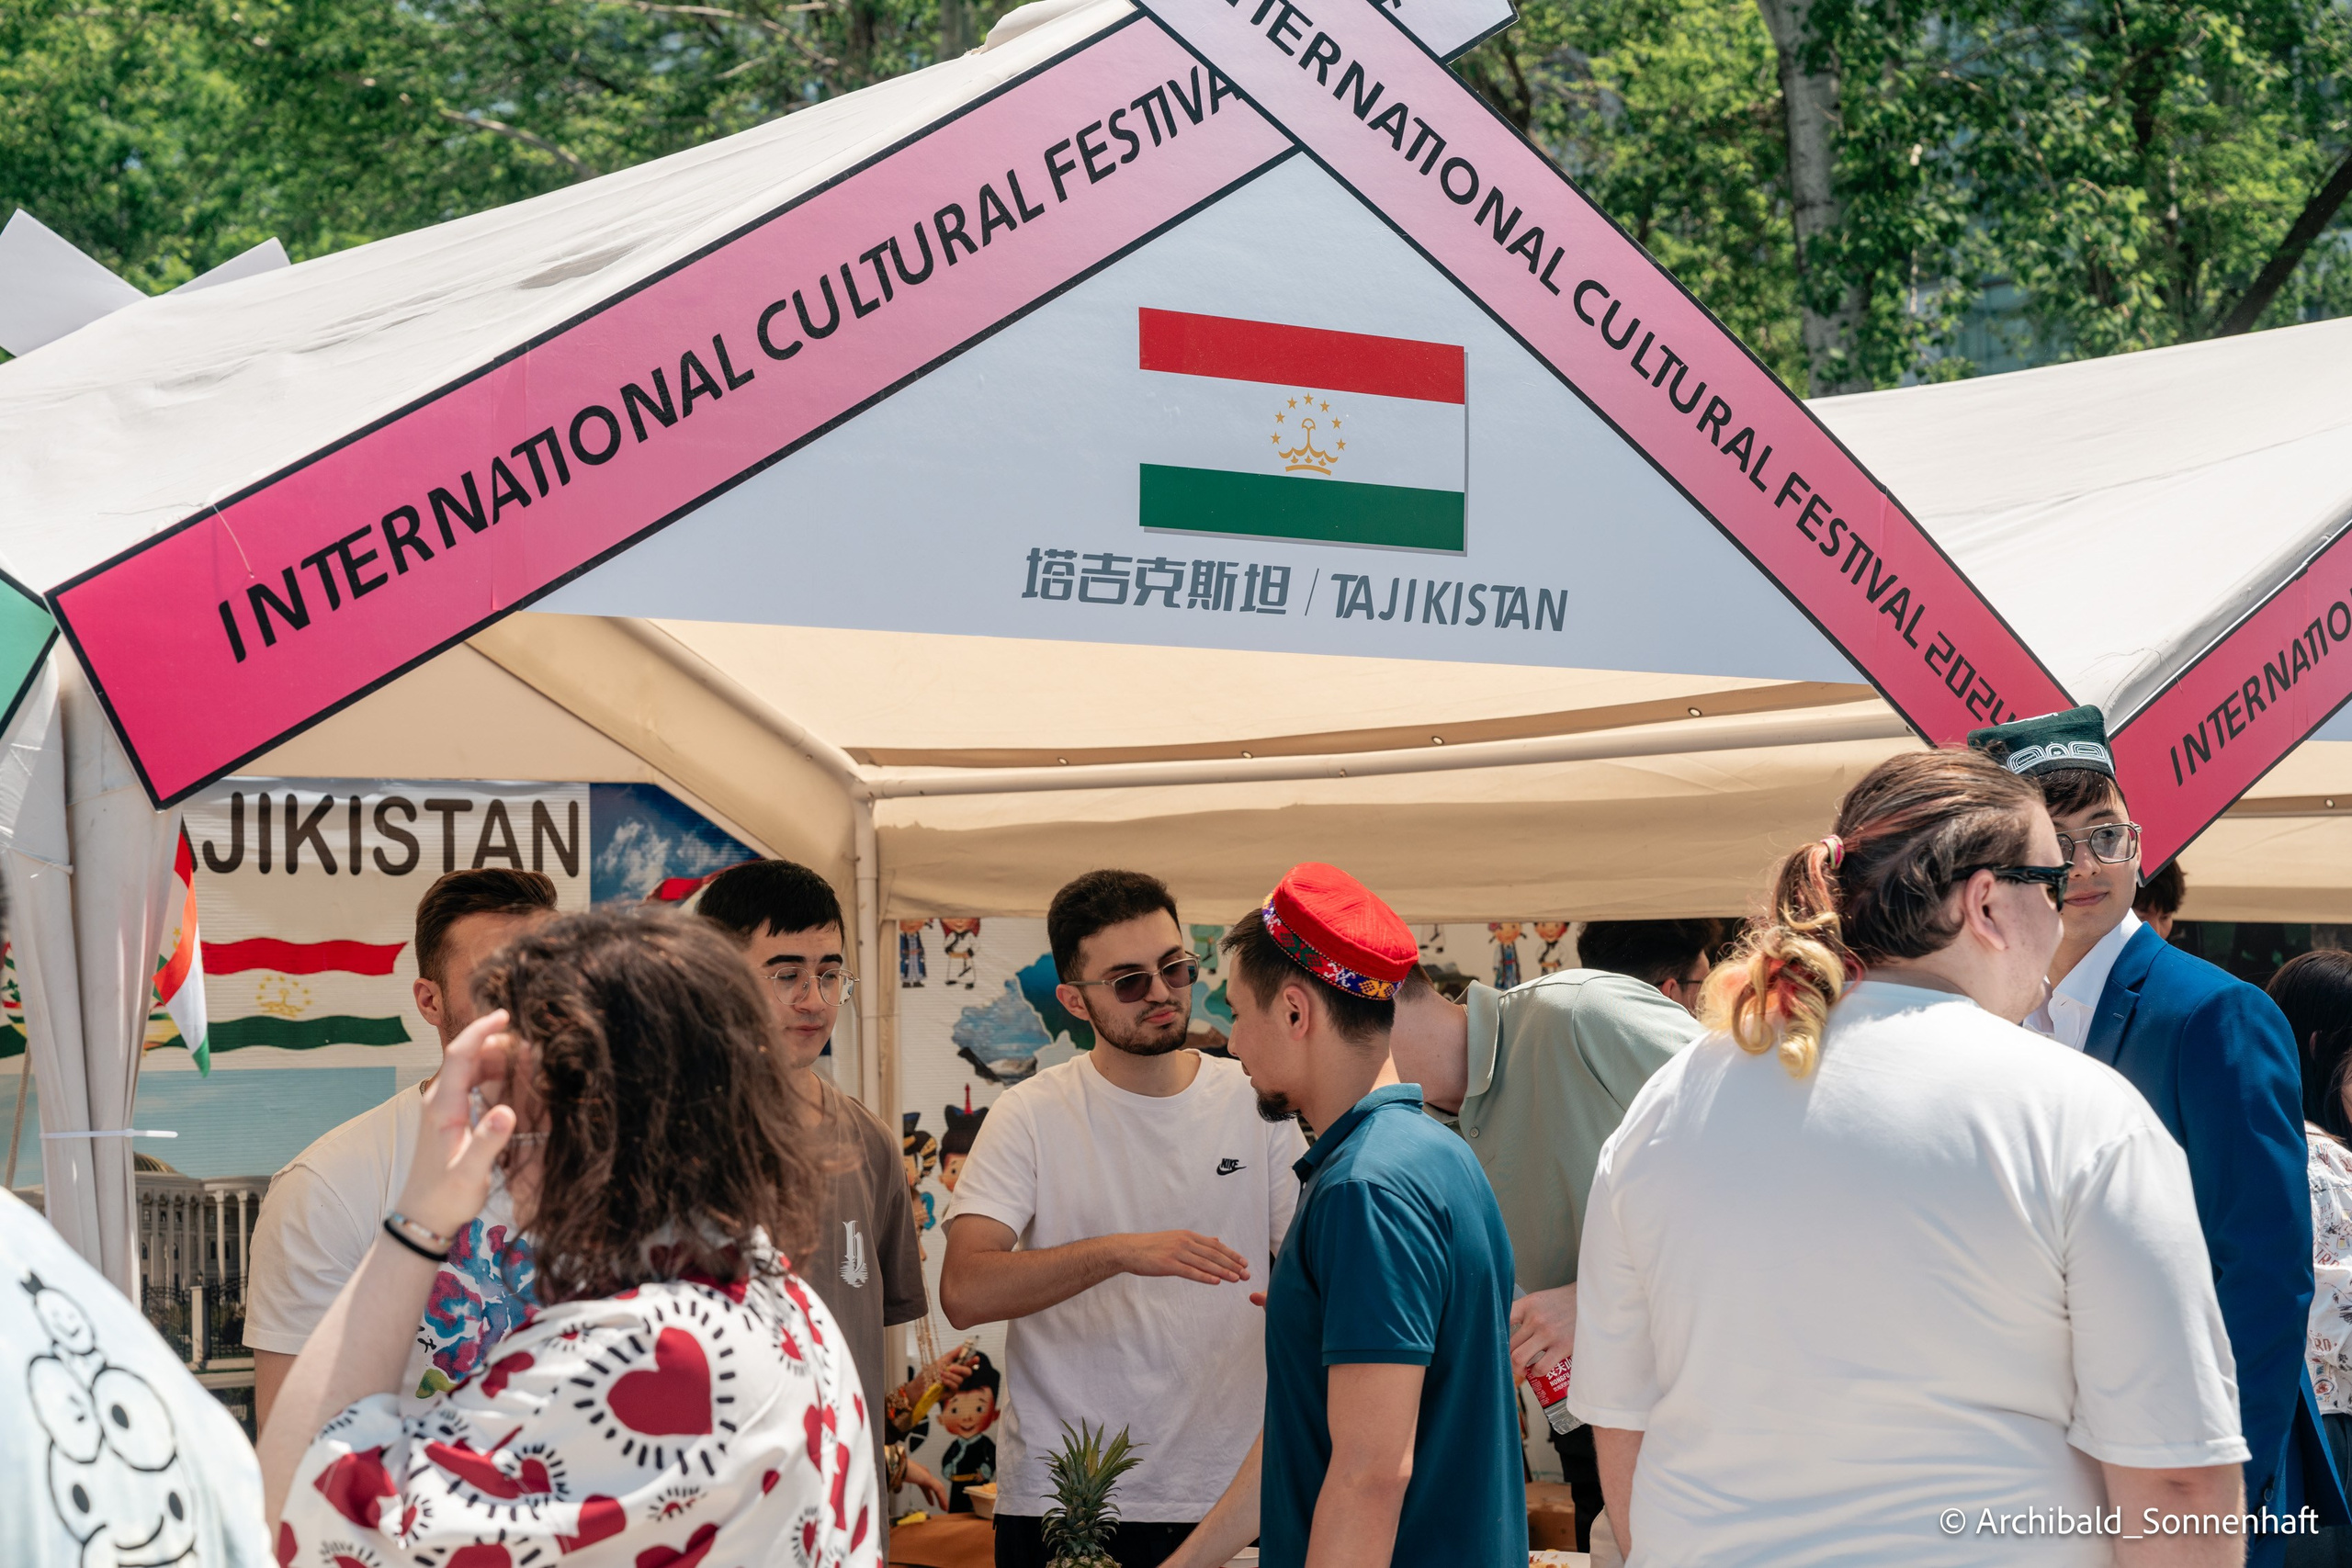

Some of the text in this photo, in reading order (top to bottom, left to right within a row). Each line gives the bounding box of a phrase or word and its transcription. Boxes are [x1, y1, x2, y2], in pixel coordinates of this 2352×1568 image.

[219, 66, 1244, 663] INTERNATIONAL CULTURAL FESTIVA
[1226, 0, 1566, 296] TERNATIONAL
[1574, 280, 1773, 492] CULTURAL
[1774, 471, 1919, 649] FESTIVAL
[1021, 547, 1569, 632] 塔吉克斯坦 TAJIKISTAN
[2170, 588, 2352, 787] INTERNATIO
[1220, 1157, 1239, 1170] NIKE
